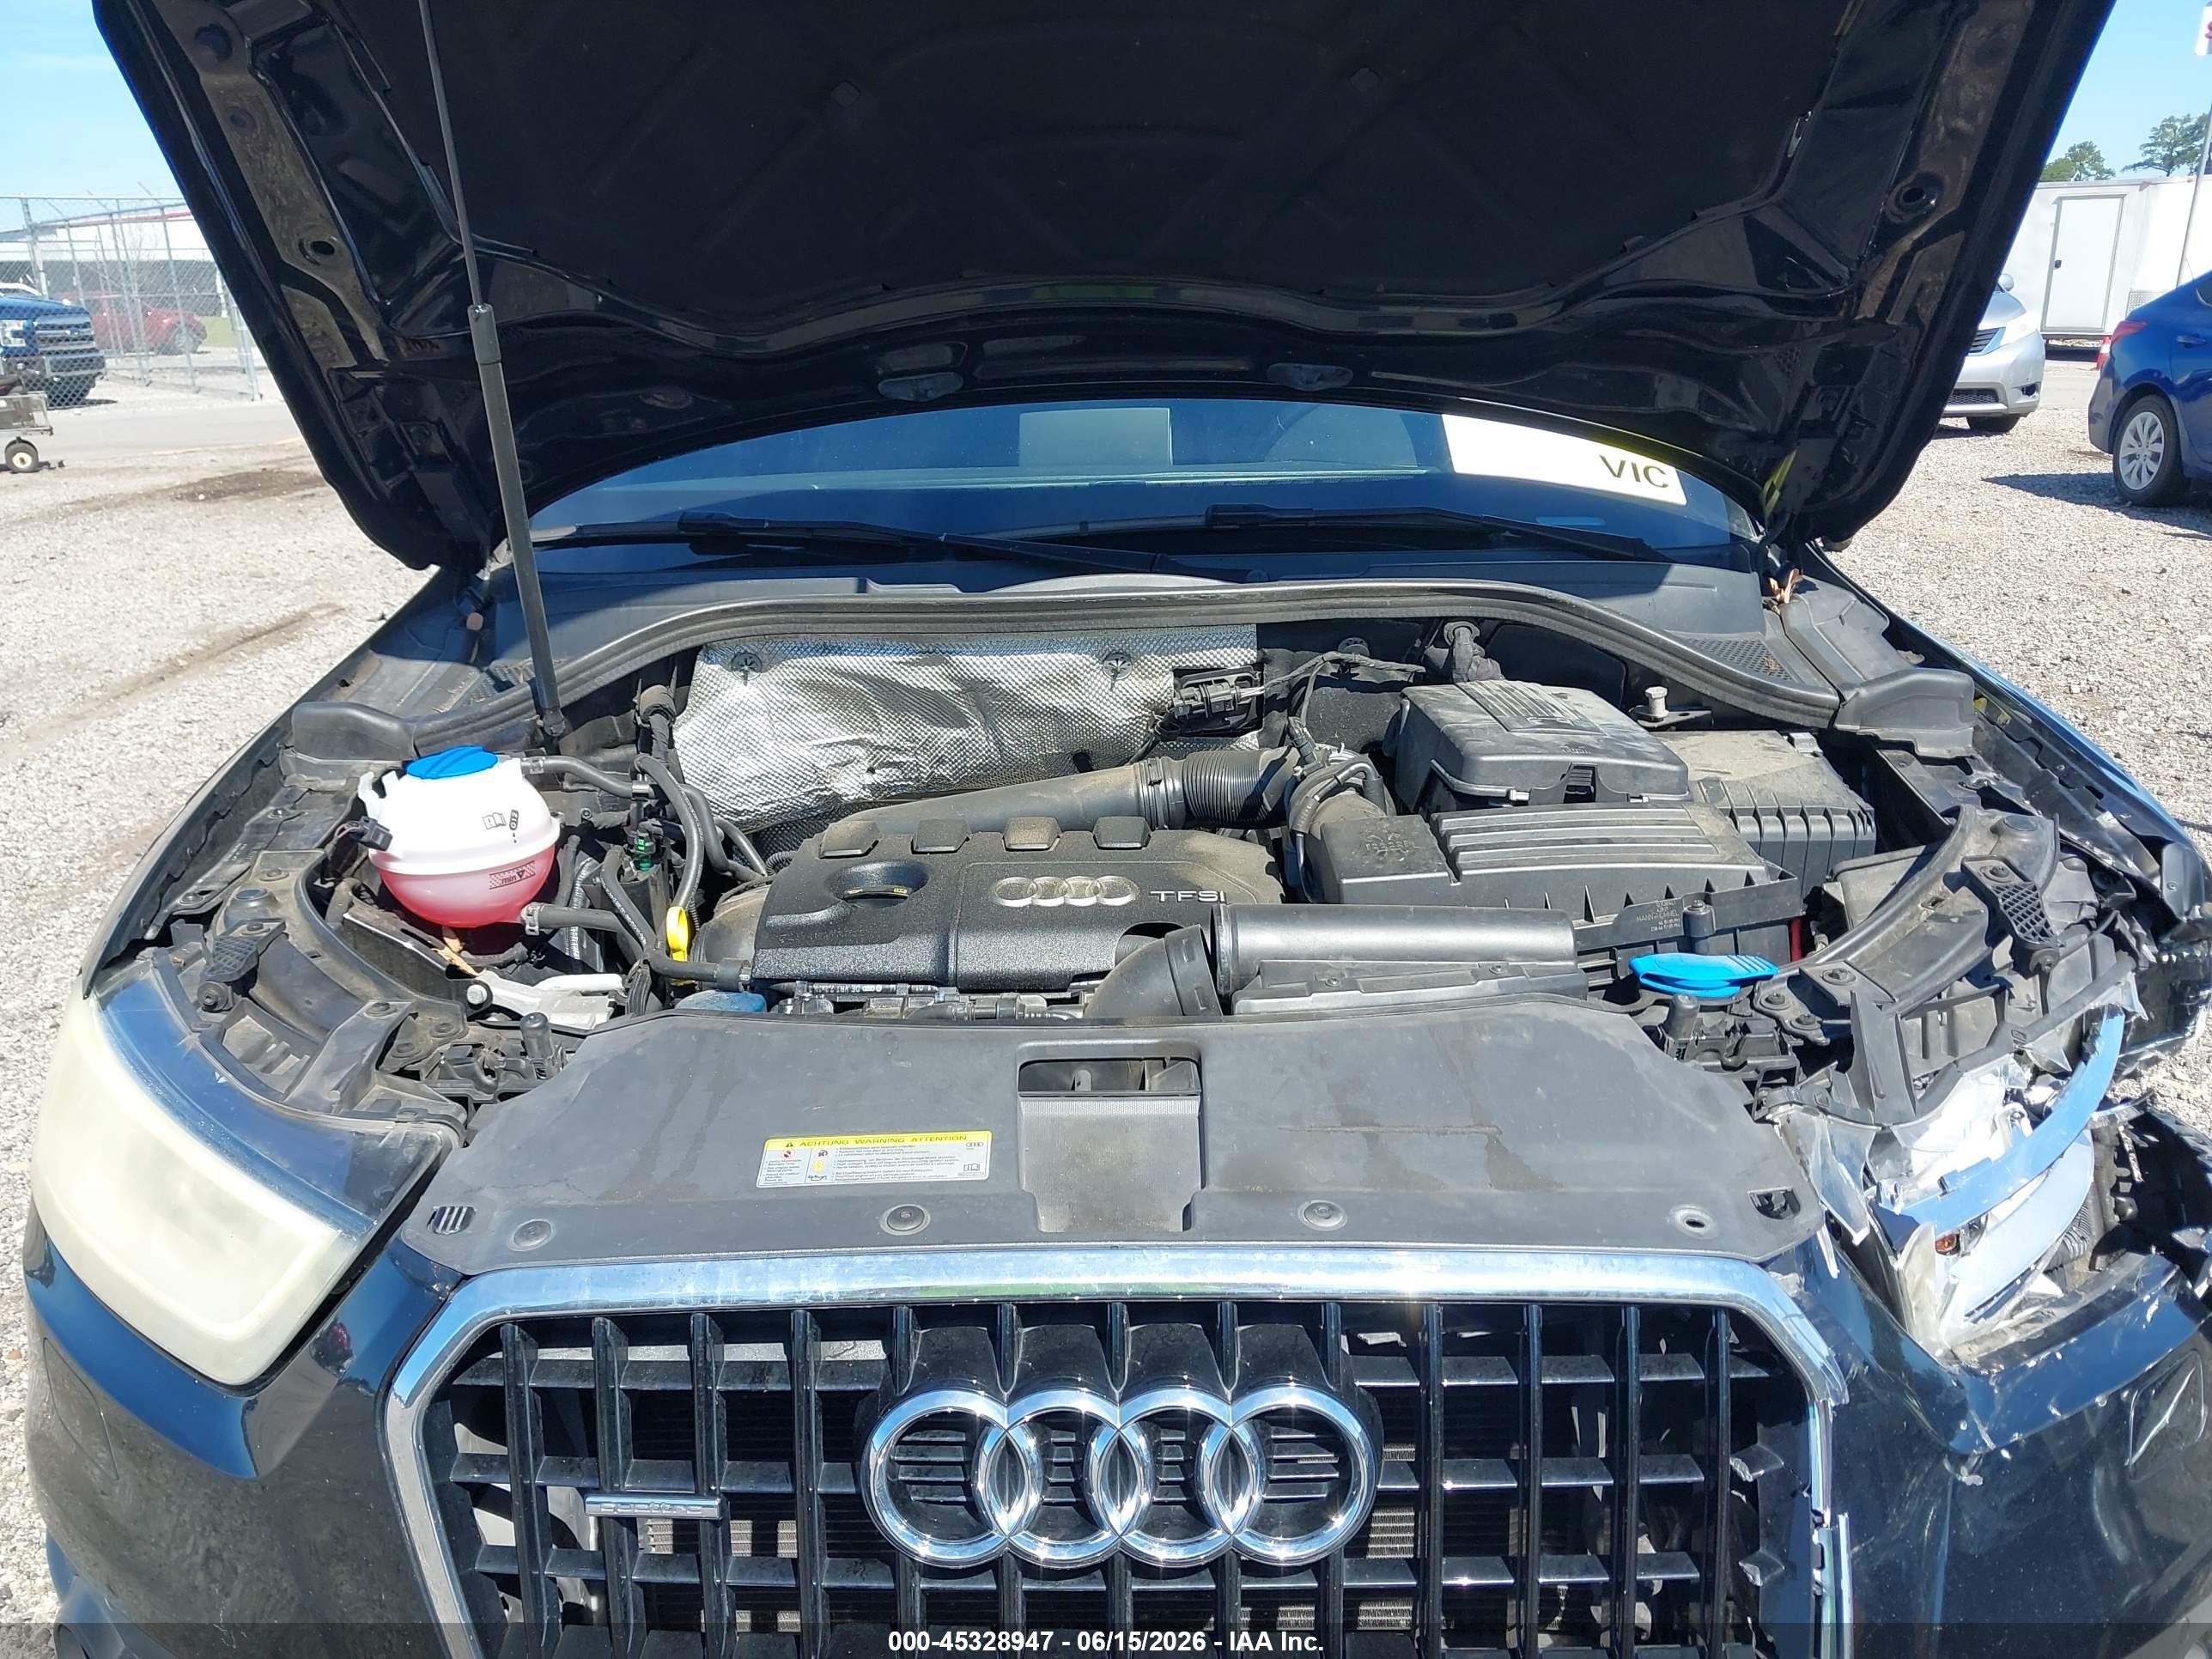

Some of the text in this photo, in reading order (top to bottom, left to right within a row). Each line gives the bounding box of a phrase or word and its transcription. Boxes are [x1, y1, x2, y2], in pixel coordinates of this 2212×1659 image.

[1599, 453, 1669, 489] VIC
[501, 875, 517, 884] min
[1150, 890, 1226, 903] TFSI
[910, 1134, 967, 1143] ATTENTION
